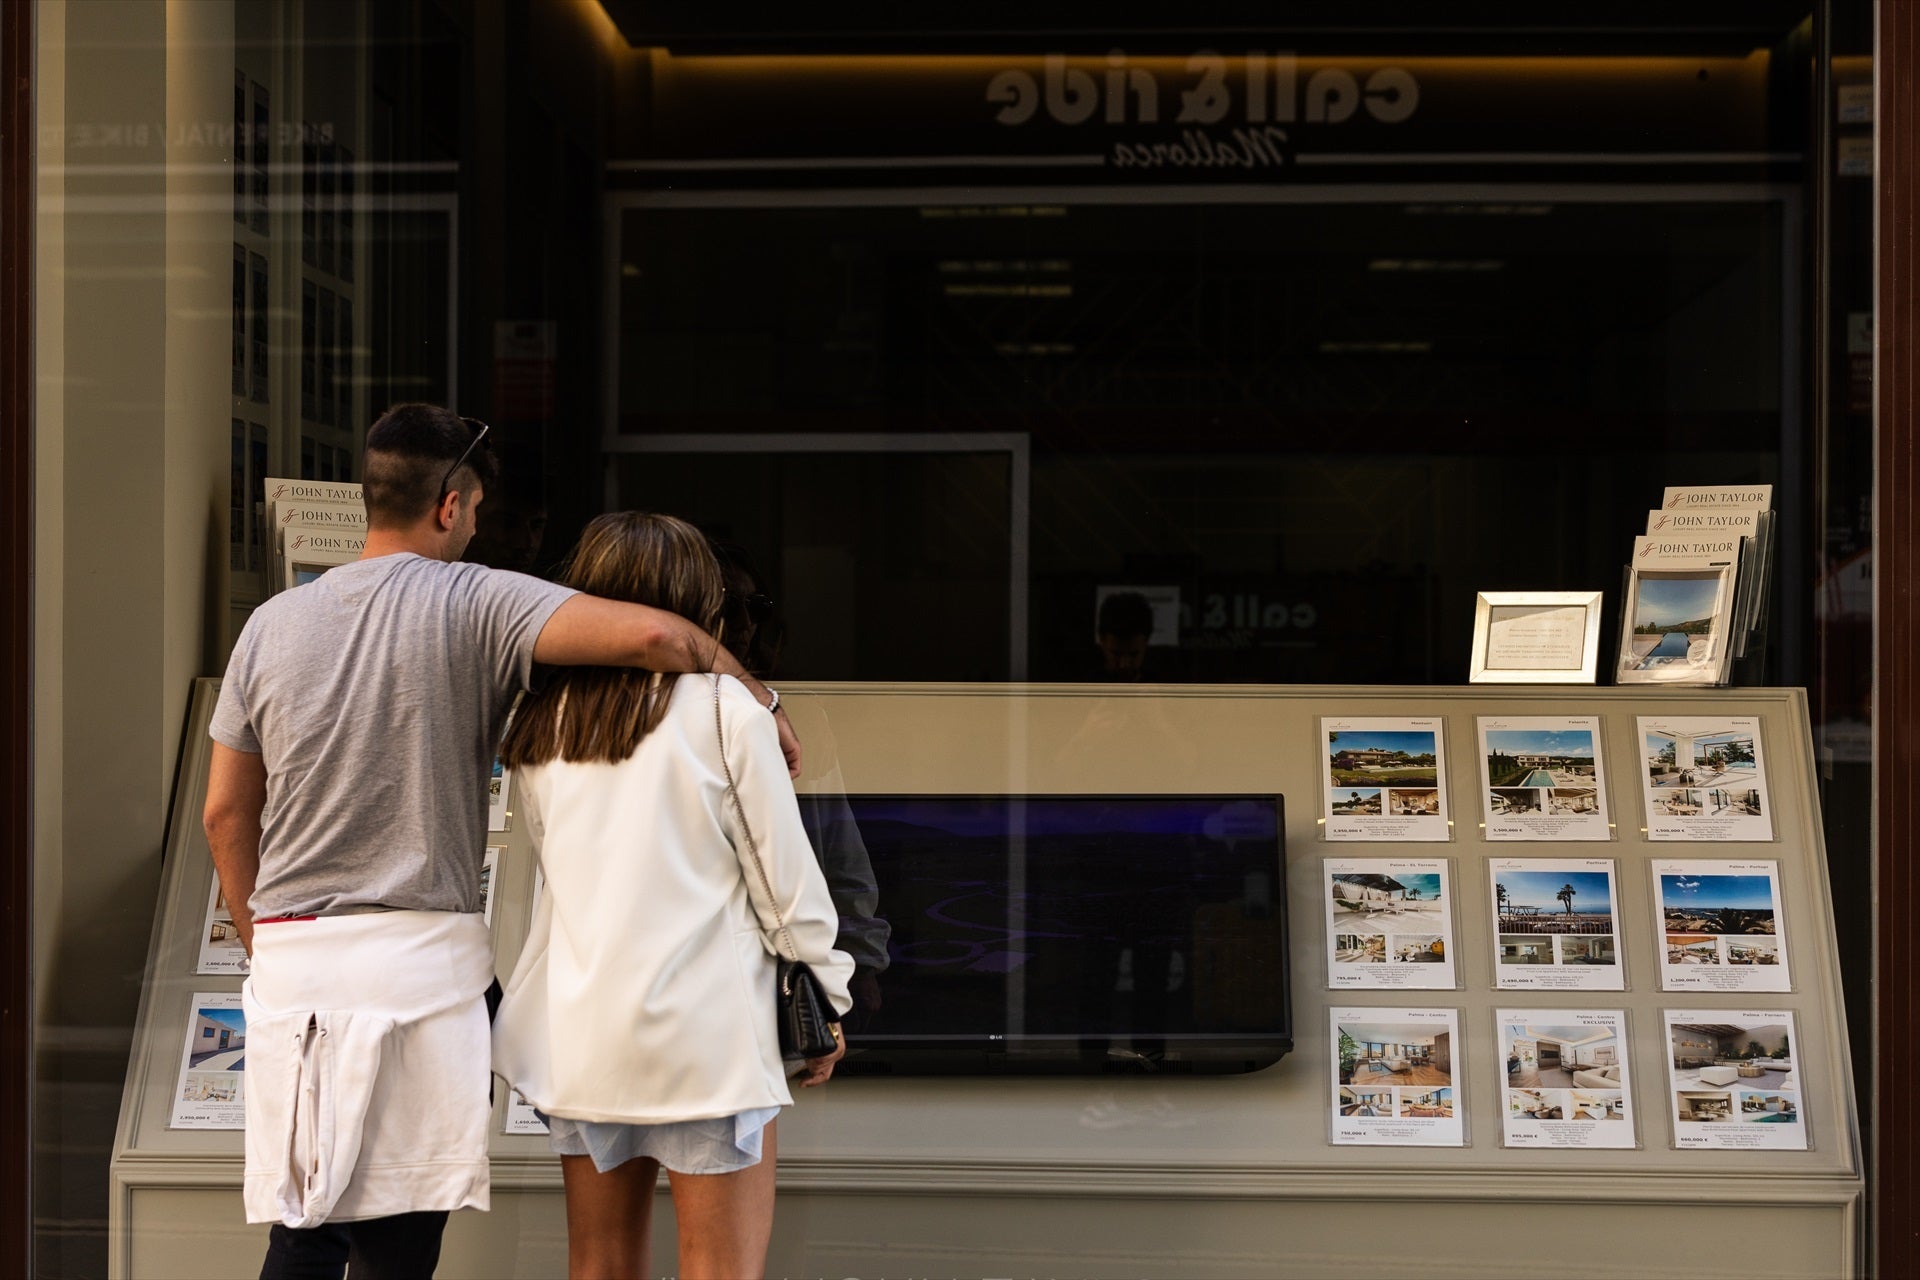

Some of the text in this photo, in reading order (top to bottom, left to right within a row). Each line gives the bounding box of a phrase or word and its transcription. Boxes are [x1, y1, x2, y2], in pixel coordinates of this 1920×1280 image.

[291, 486, 363, 500] JOHN TAYLO
[1686, 493, 1764, 504] JOHN TAYLOR
[301, 511, 369, 524] JOHN TAYL
[1672, 516, 1751, 526] JOHN TAYLOR
[310, 537, 341, 548] JOHN
[1658, 543, 1733, 554] JOHN TAYLOR
